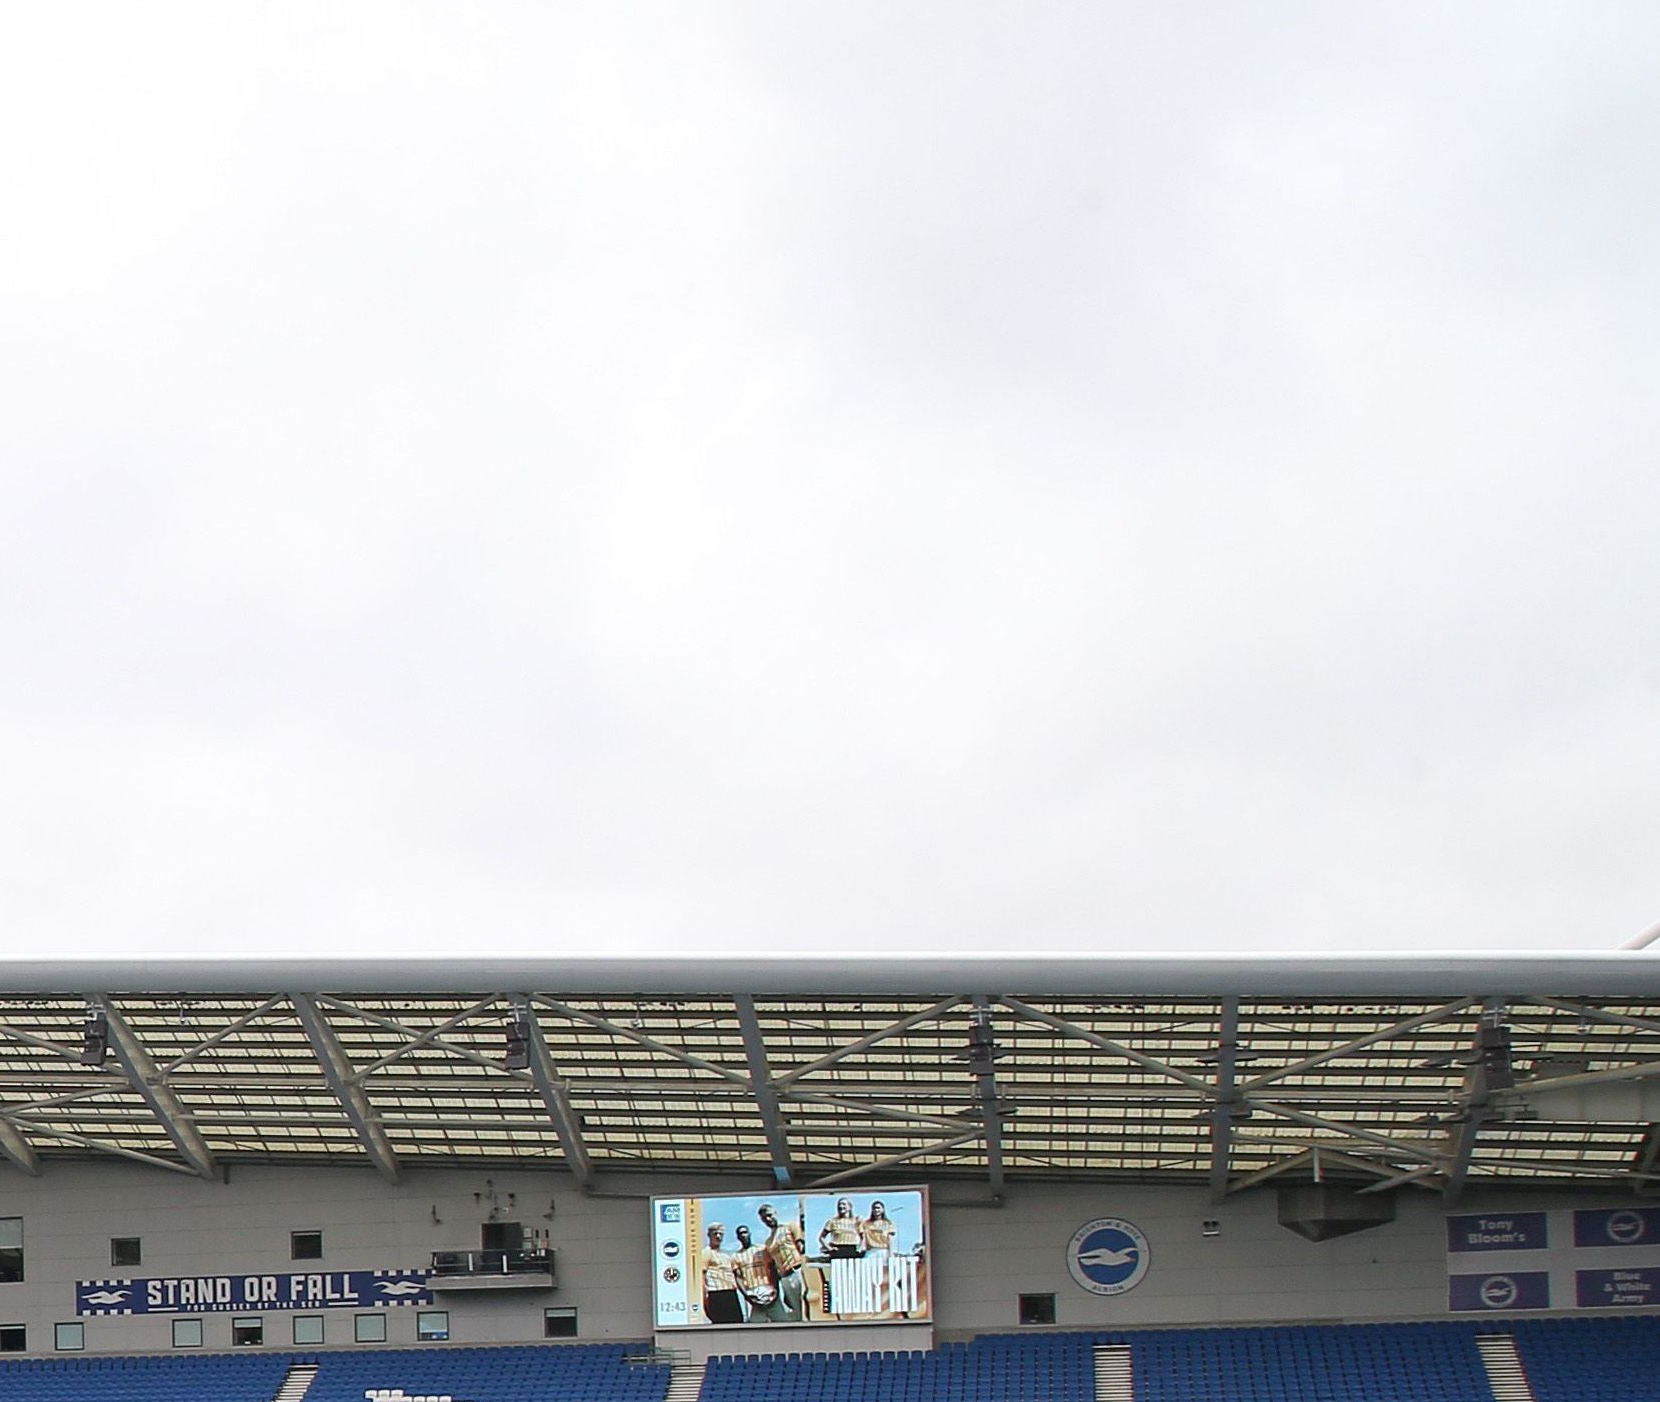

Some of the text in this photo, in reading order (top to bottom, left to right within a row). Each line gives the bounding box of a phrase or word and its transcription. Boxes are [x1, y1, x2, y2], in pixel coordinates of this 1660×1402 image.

[1478, 1219, 1514, 1231] Tony
[1467, 1232, 1526, 1244] Bloom's
[147, 1273, 359, 1306] STAND OR FALL
[831, 1257, 883, 1313] AWAY
[888, 1256, 920, 1312] KIT
[660, 1302, 686, 1312] 12:43
